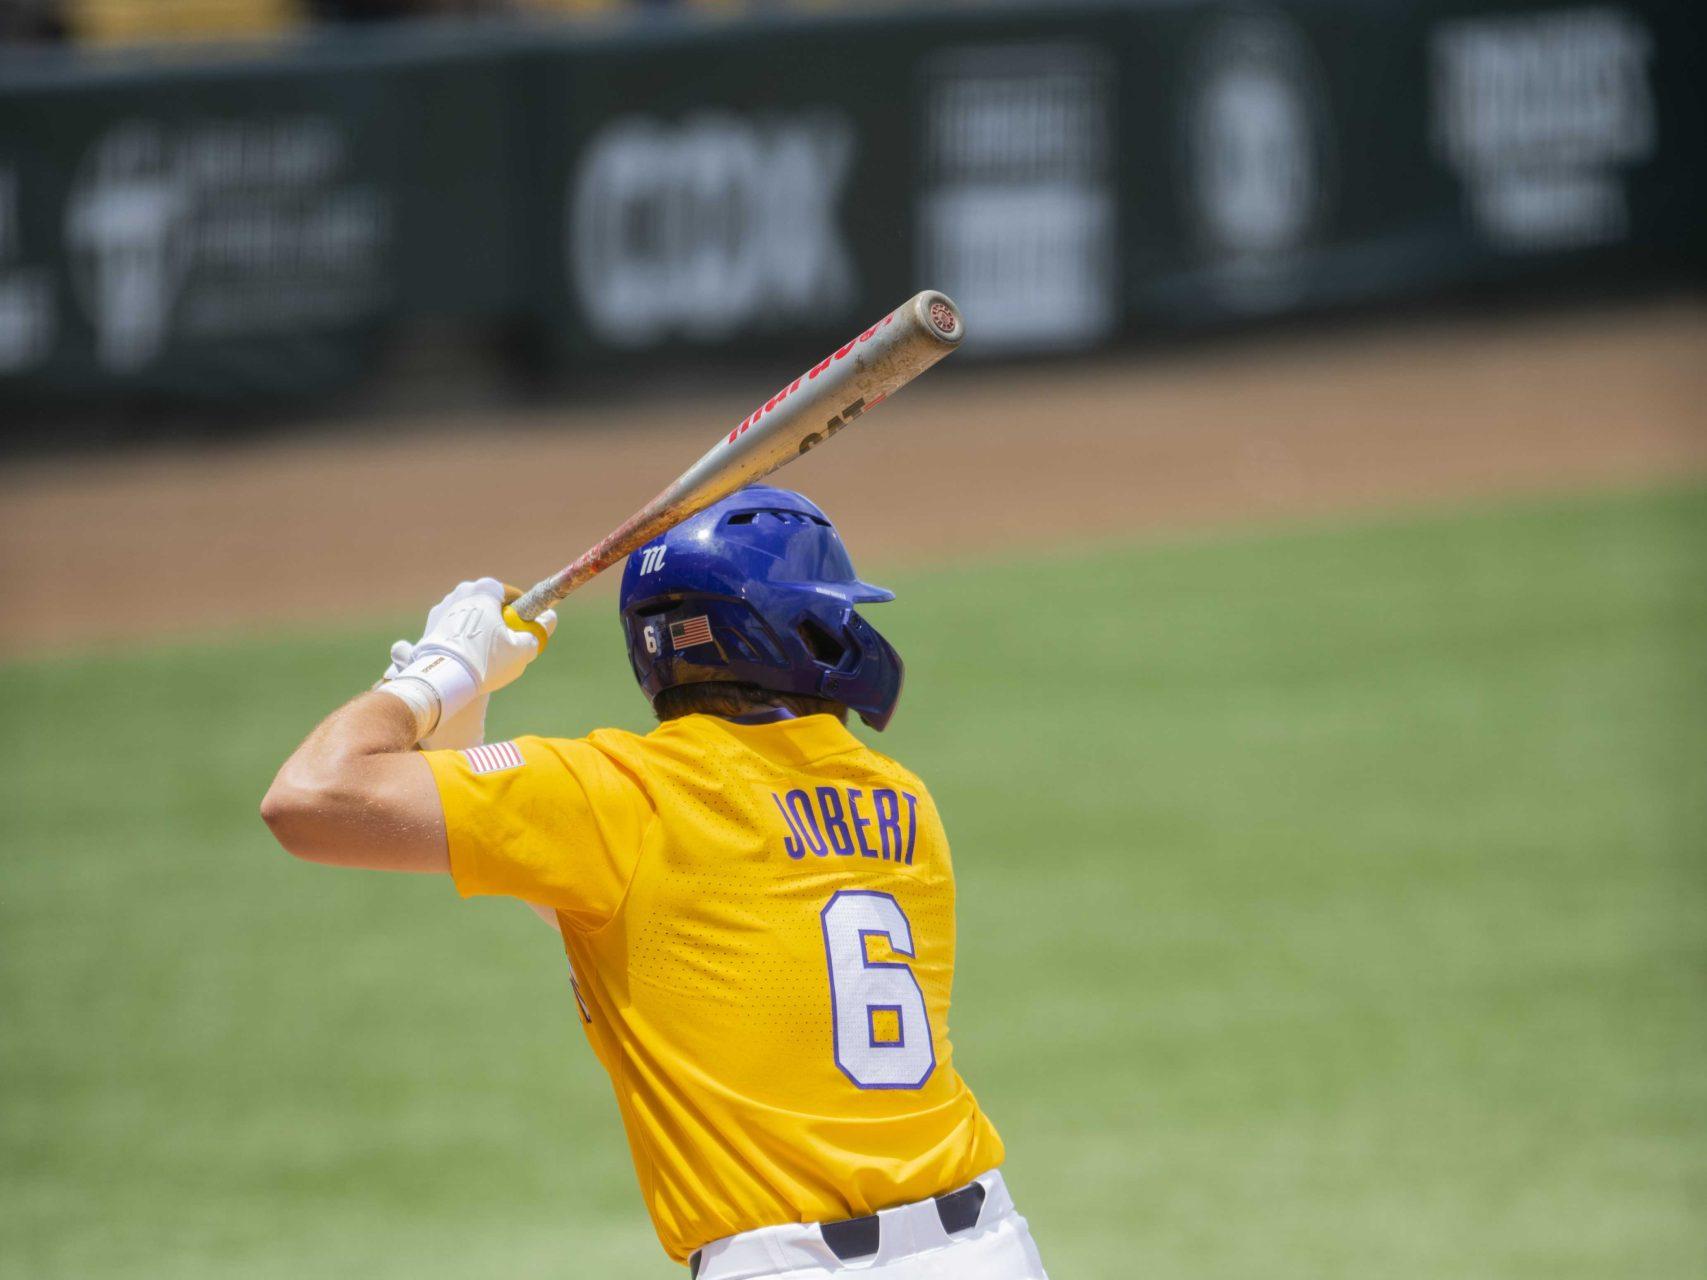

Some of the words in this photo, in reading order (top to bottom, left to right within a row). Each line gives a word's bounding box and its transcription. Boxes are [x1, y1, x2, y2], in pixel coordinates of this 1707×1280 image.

[643, 625, 657, 653] 6
[772, 786, 918, 866] JOBERT
[820, 890, 936, 1090] 6
